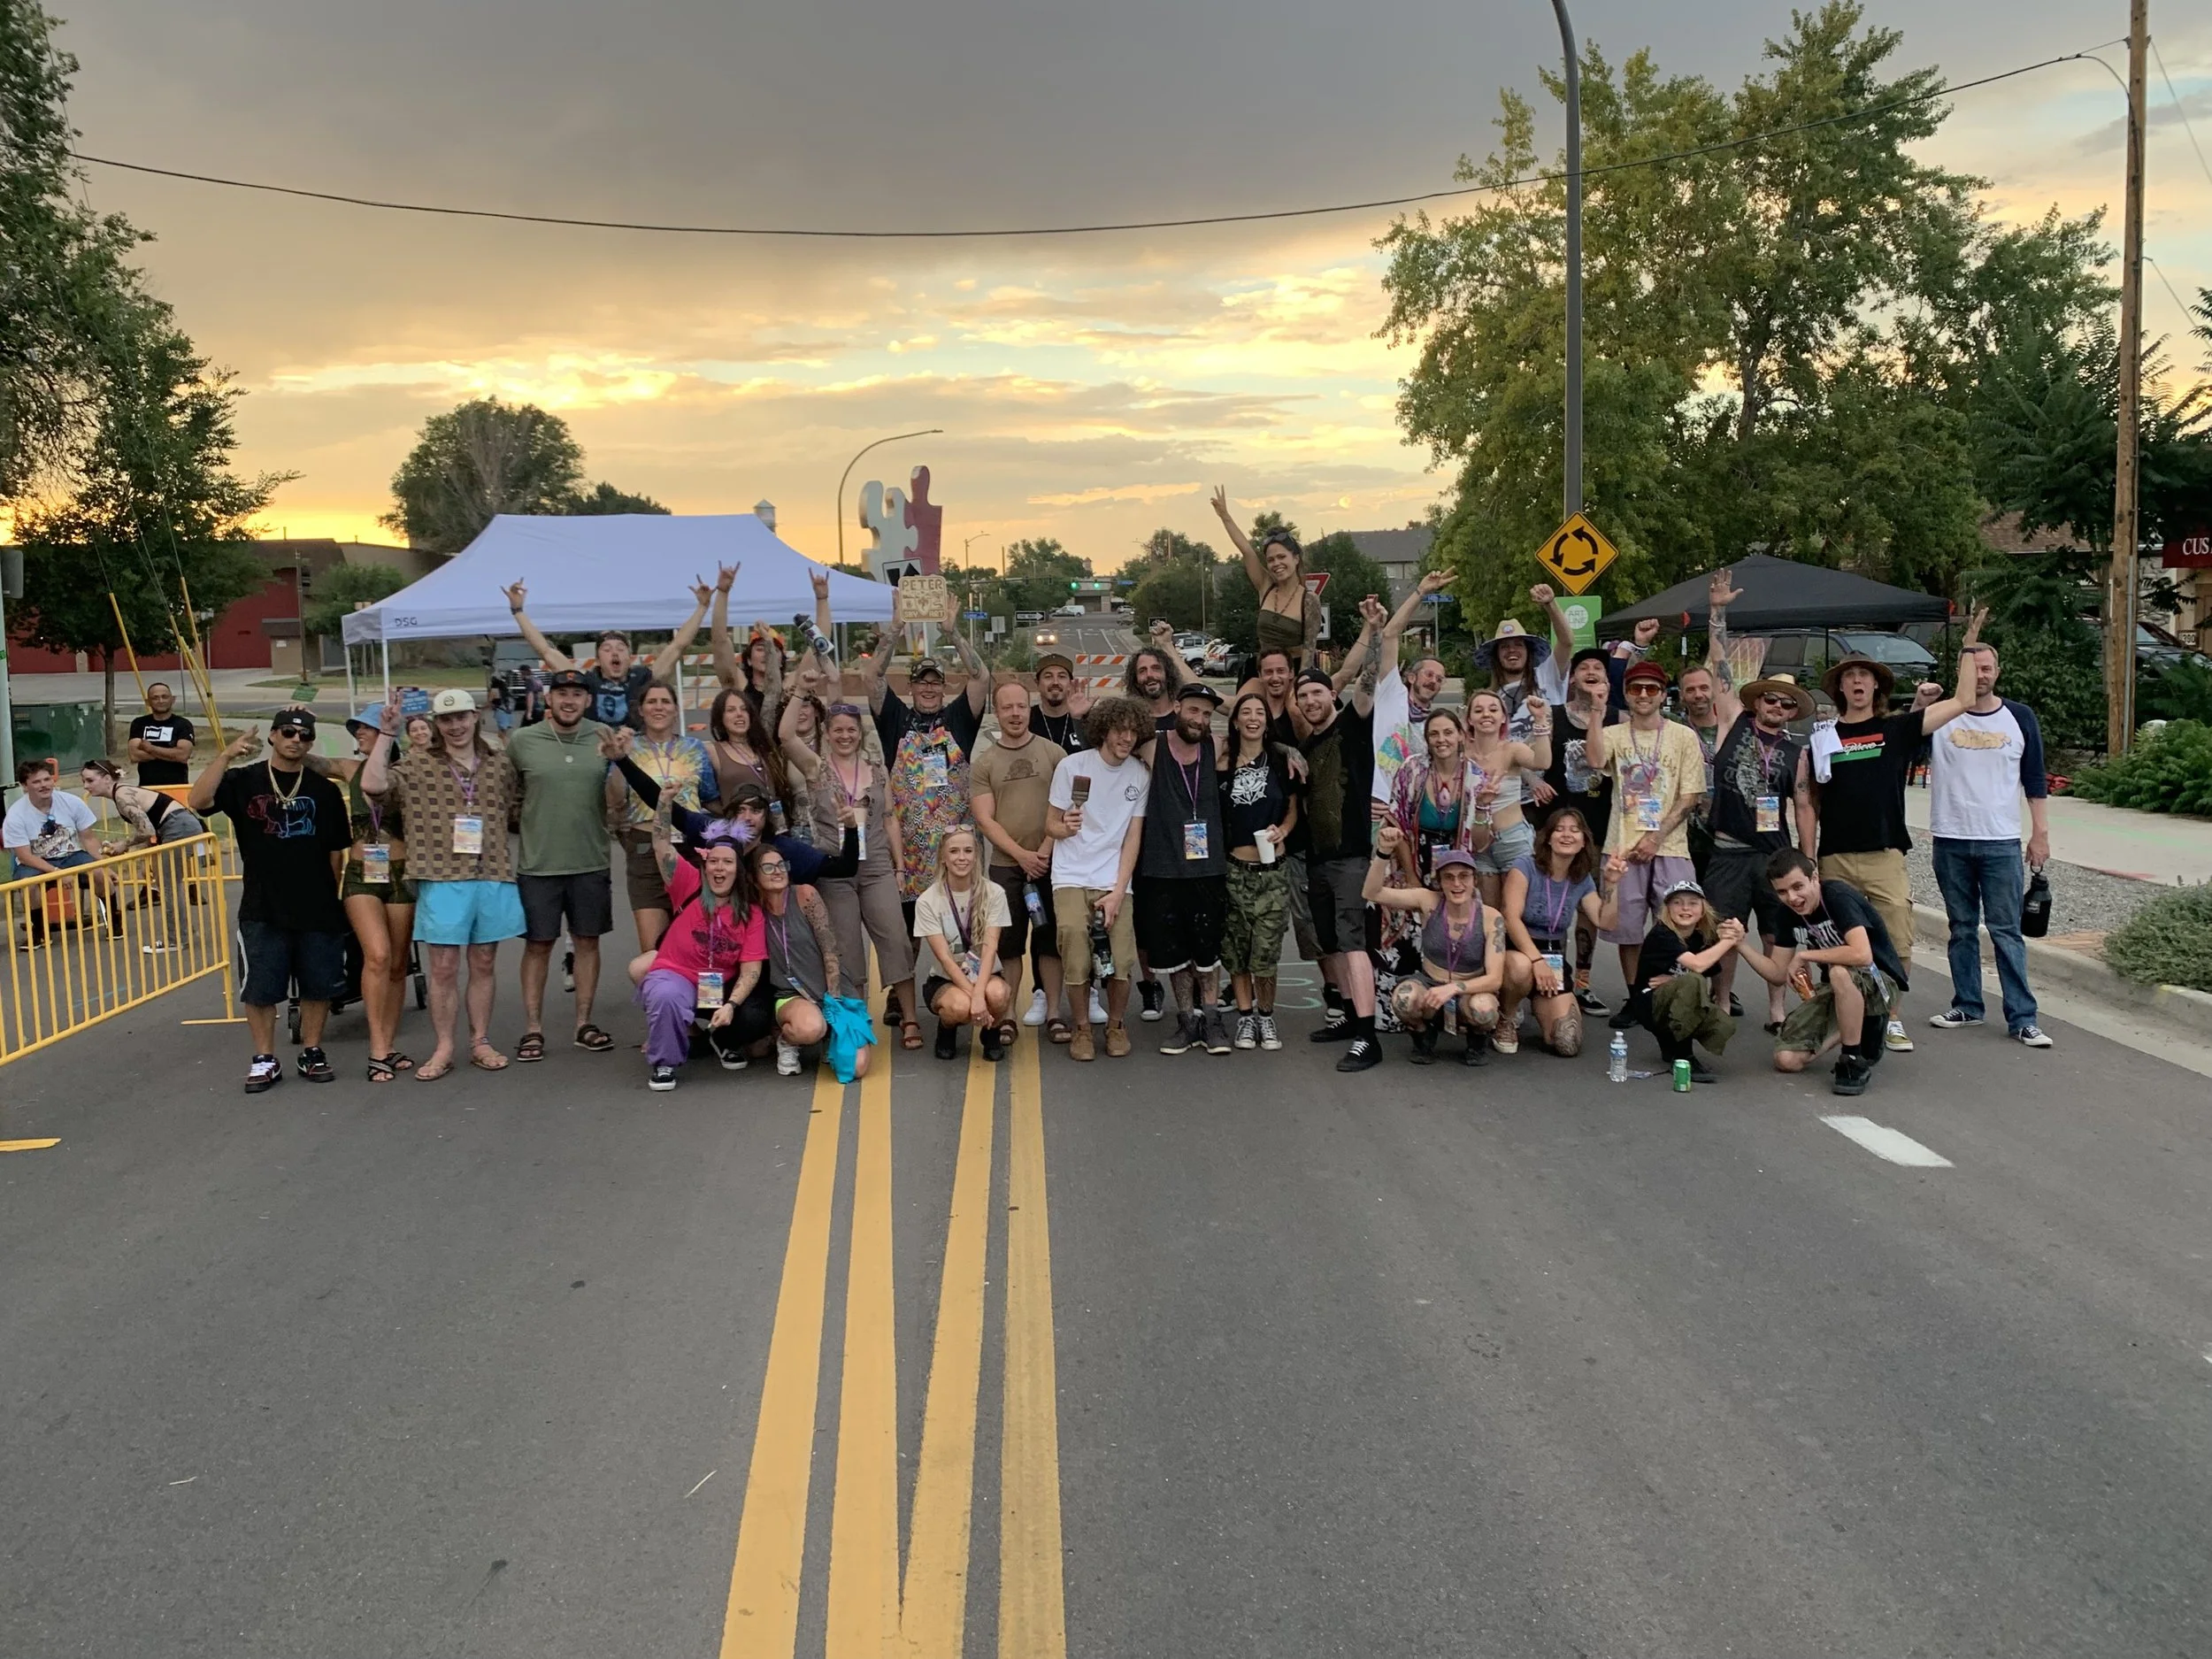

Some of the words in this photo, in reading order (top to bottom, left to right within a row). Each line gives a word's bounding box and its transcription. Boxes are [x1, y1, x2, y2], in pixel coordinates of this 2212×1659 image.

[2183, 537, 2212, 555] CUS
[902, 579, 942, 590] PETER
[395, 617, 418, 627] DSG
